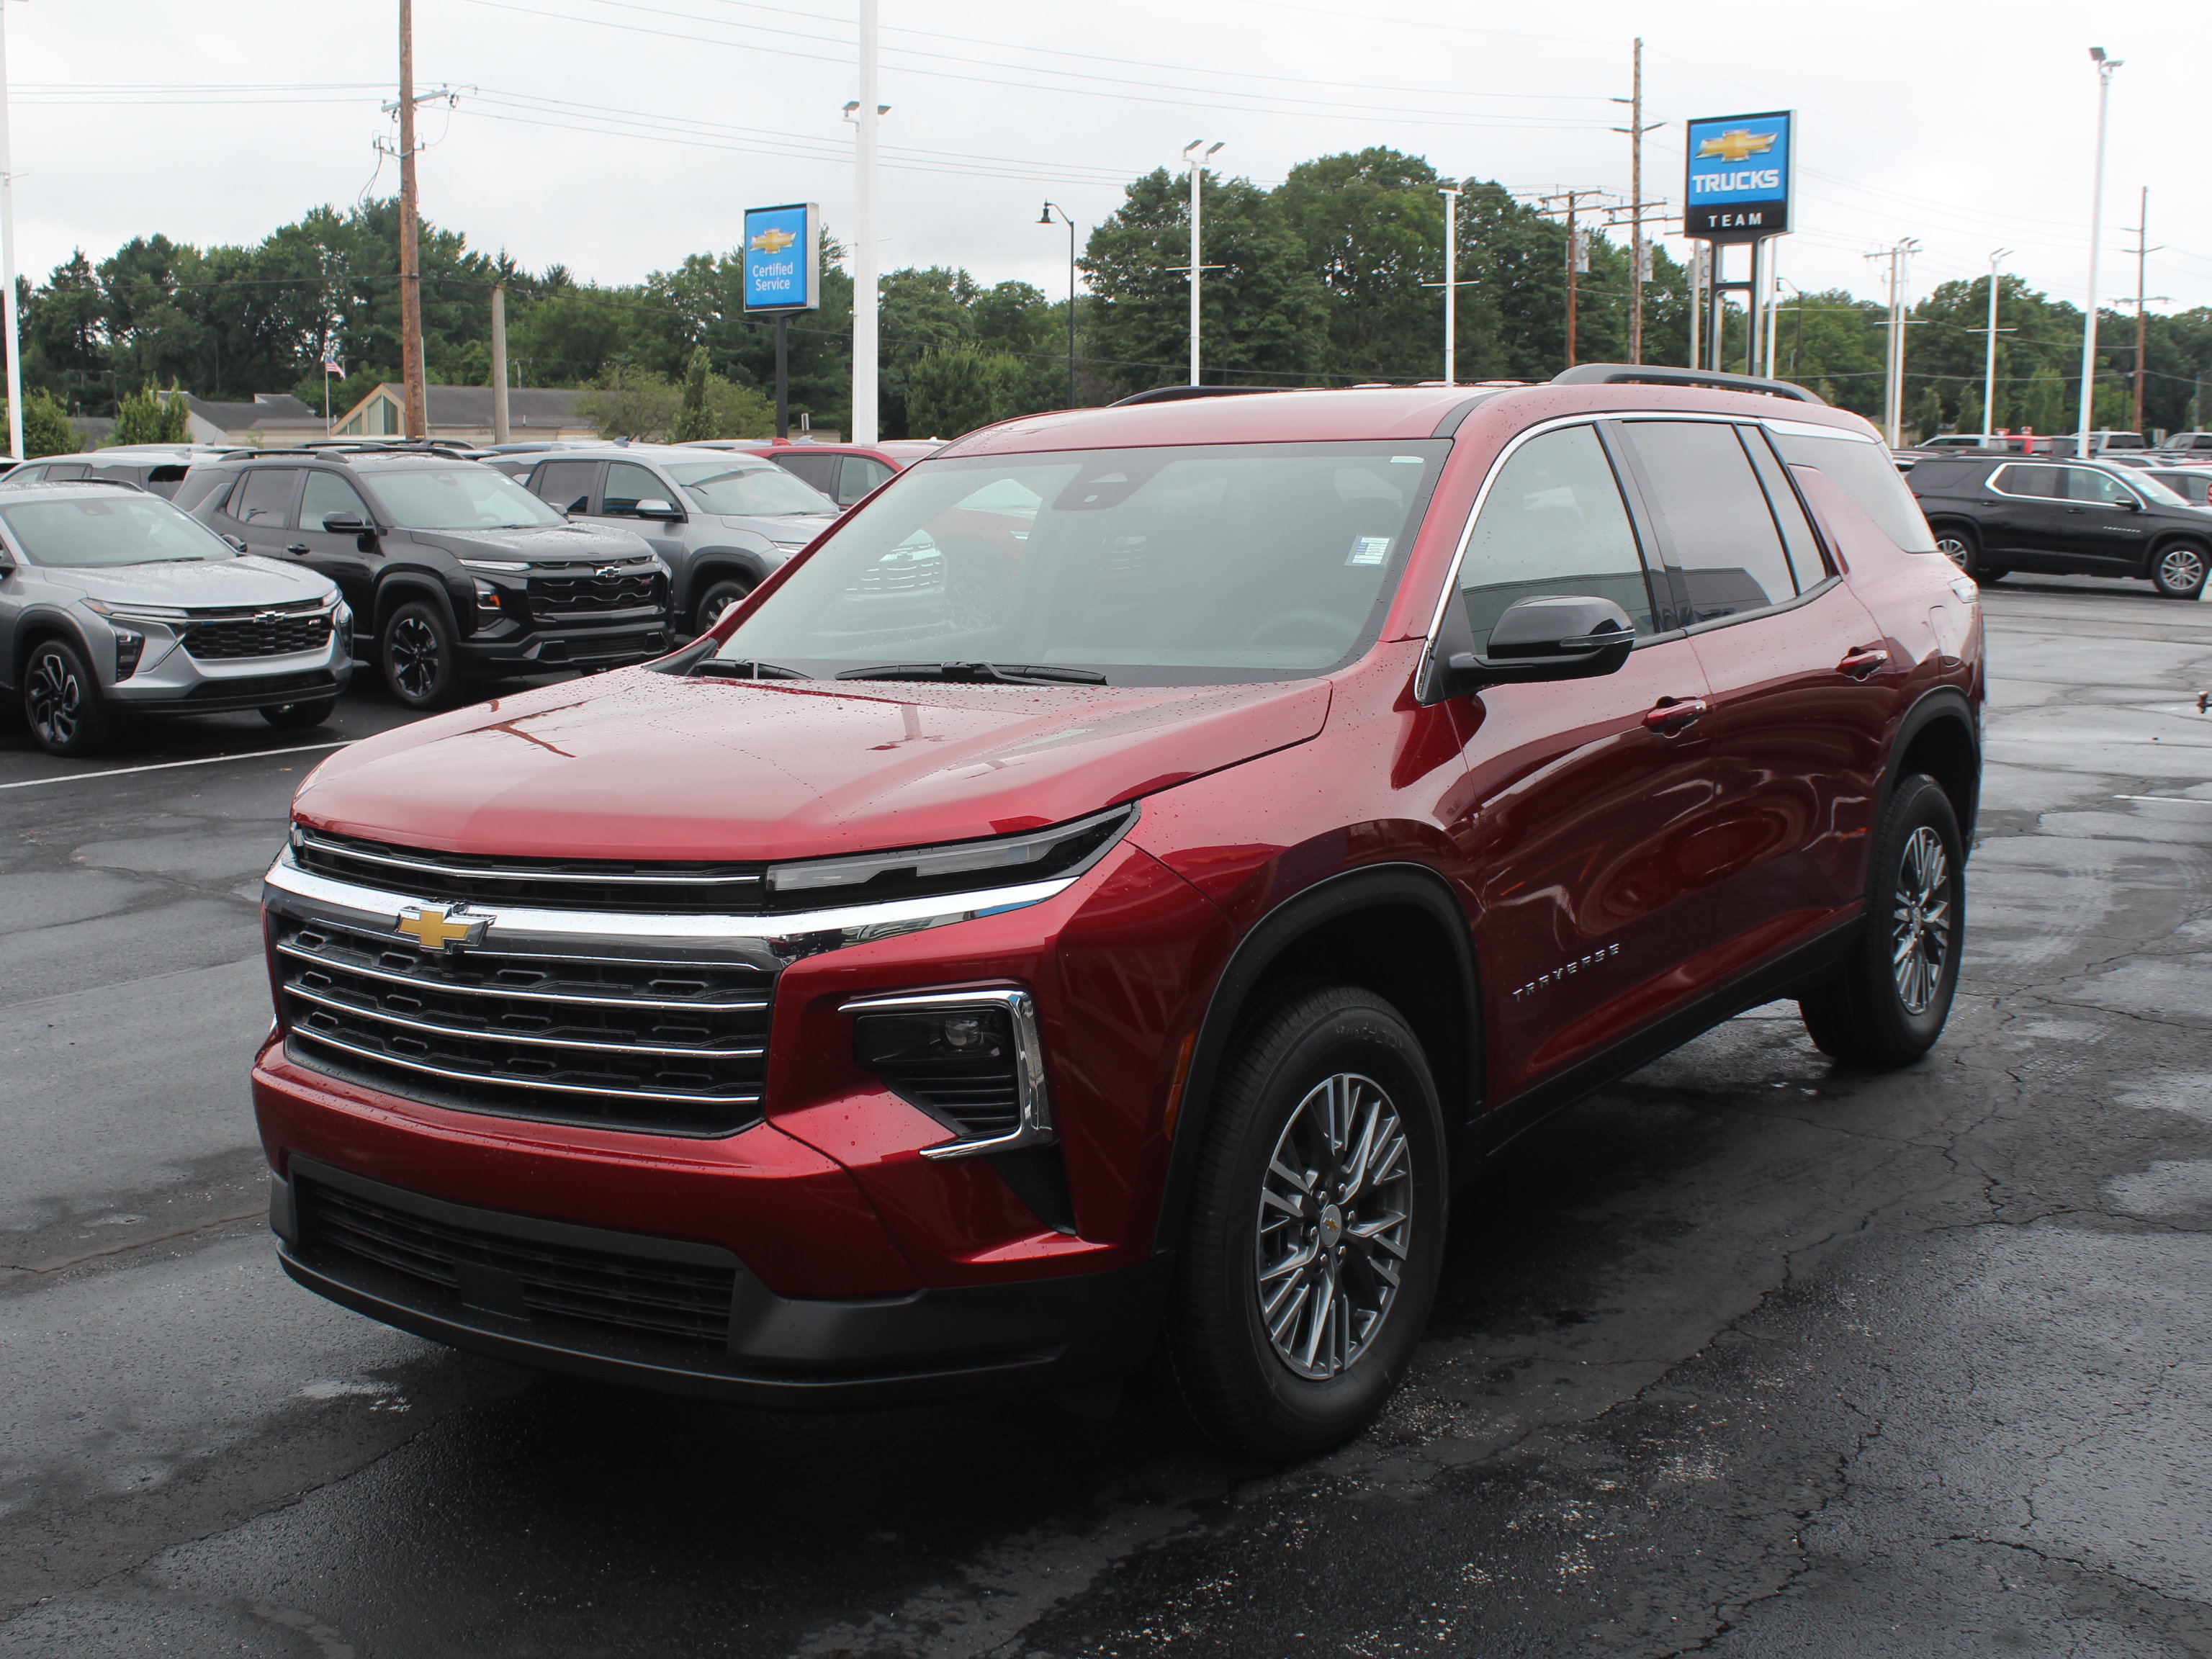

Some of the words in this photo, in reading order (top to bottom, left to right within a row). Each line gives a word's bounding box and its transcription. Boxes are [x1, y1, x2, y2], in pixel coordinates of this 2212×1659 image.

[1692, 168, 1780, 194] TRUCKS
[1708, 212, 1762, 228] TEAM
[752, 261, 793, 277] Certified
[755, 277, 791, 292] Service
[1512, 943, 1620, 1002] TRAVERSE
